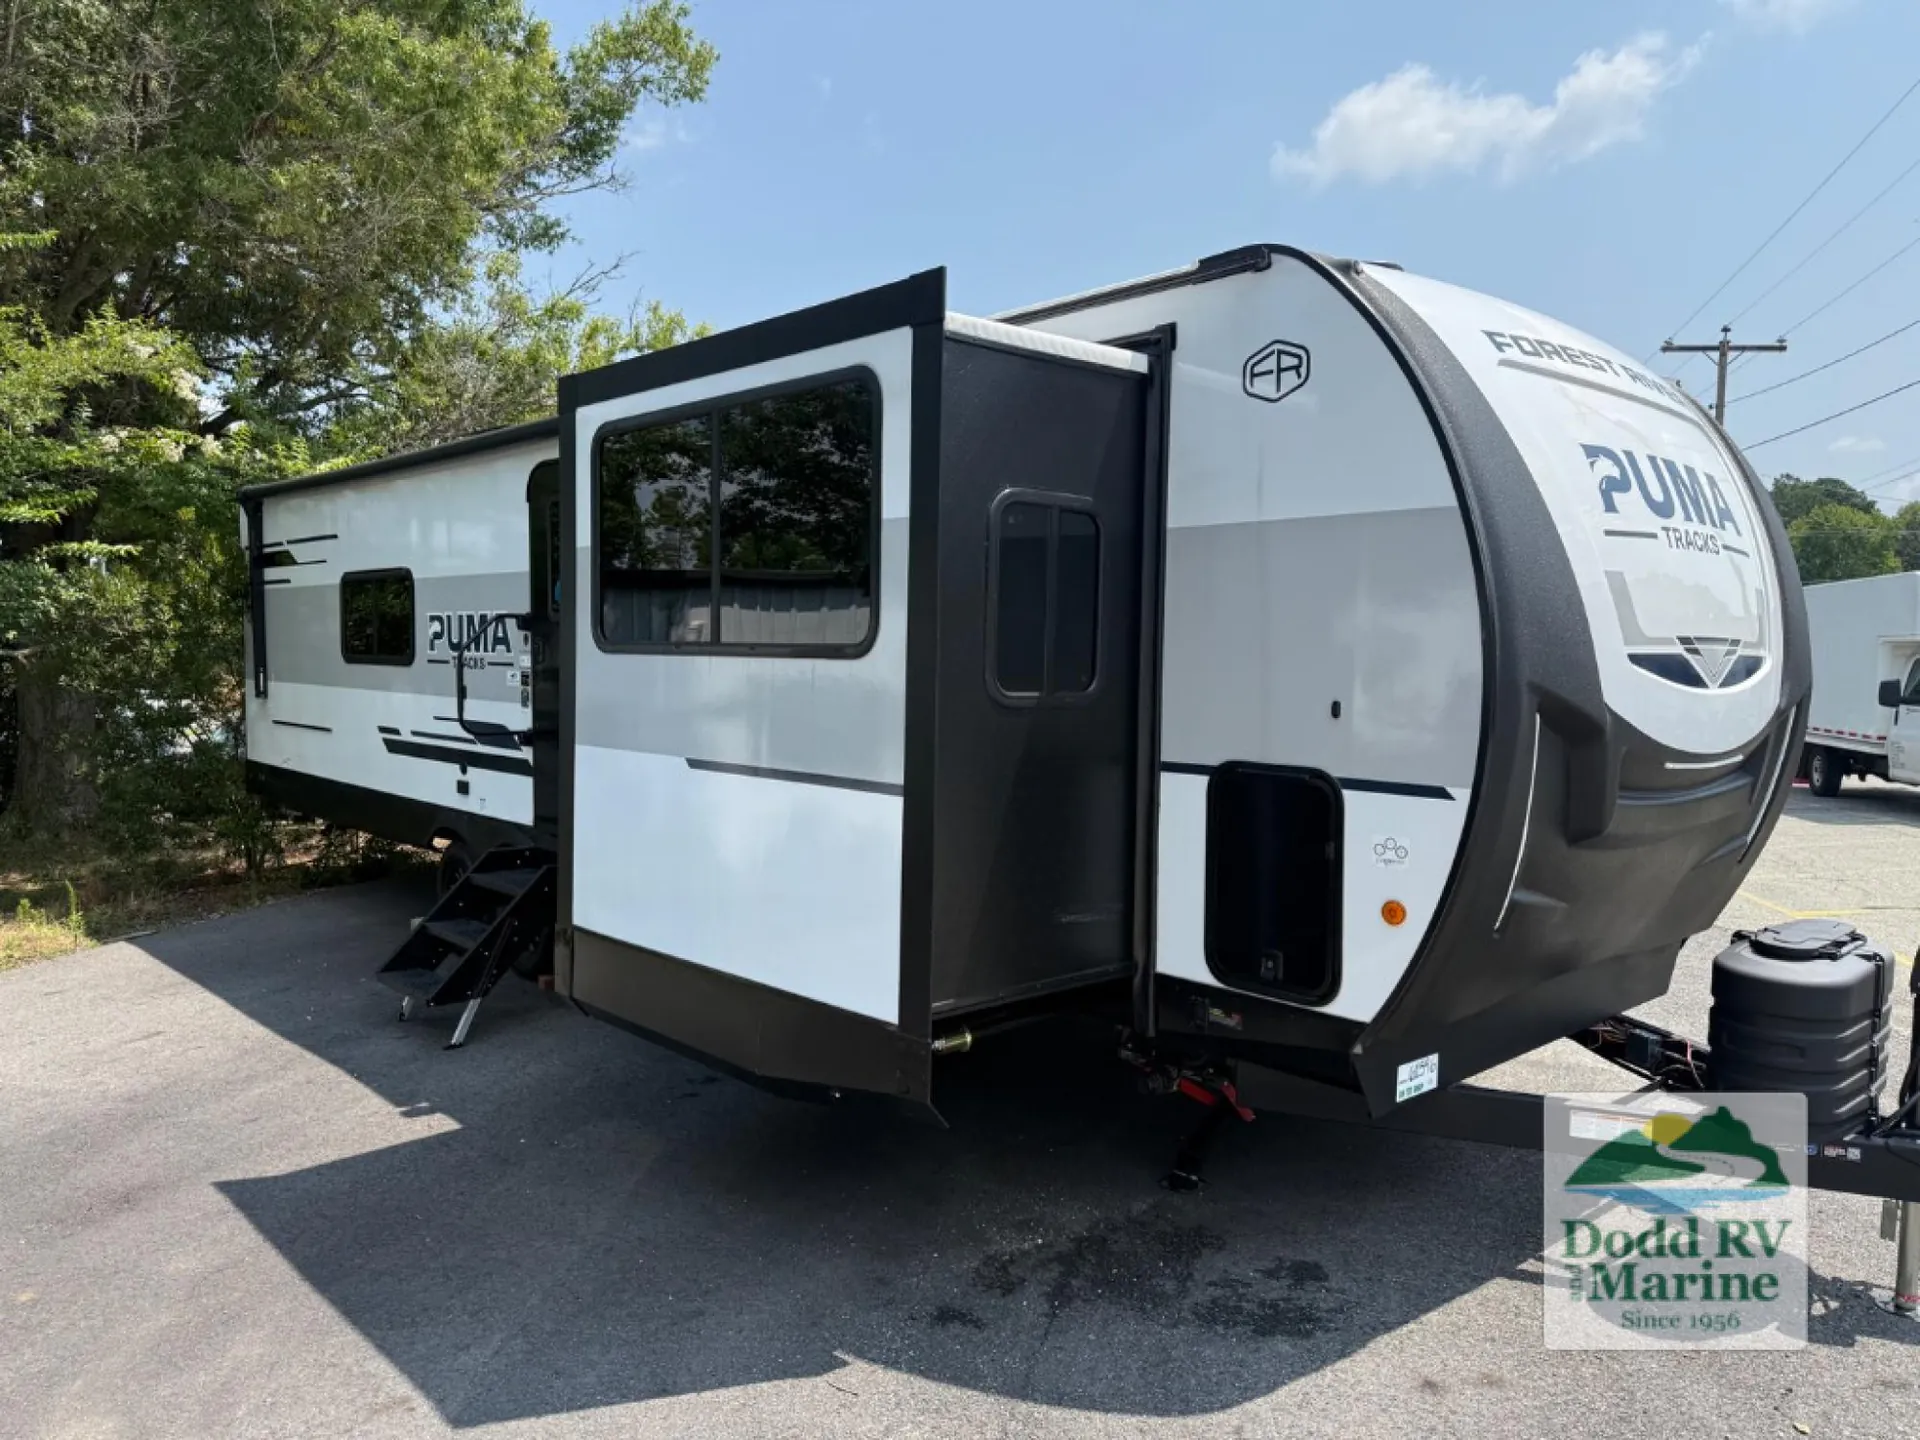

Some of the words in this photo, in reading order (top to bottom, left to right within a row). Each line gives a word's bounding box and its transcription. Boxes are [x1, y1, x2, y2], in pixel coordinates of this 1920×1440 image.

[1480, 329, 1621, 377] FOREST
[1578, 442, 1742, 537] PUMA
[1660, 526, 1720, 556] TRACKS
[427, 611, 513, 654] PUMA
[451, 655, 486, 670] TACKS
